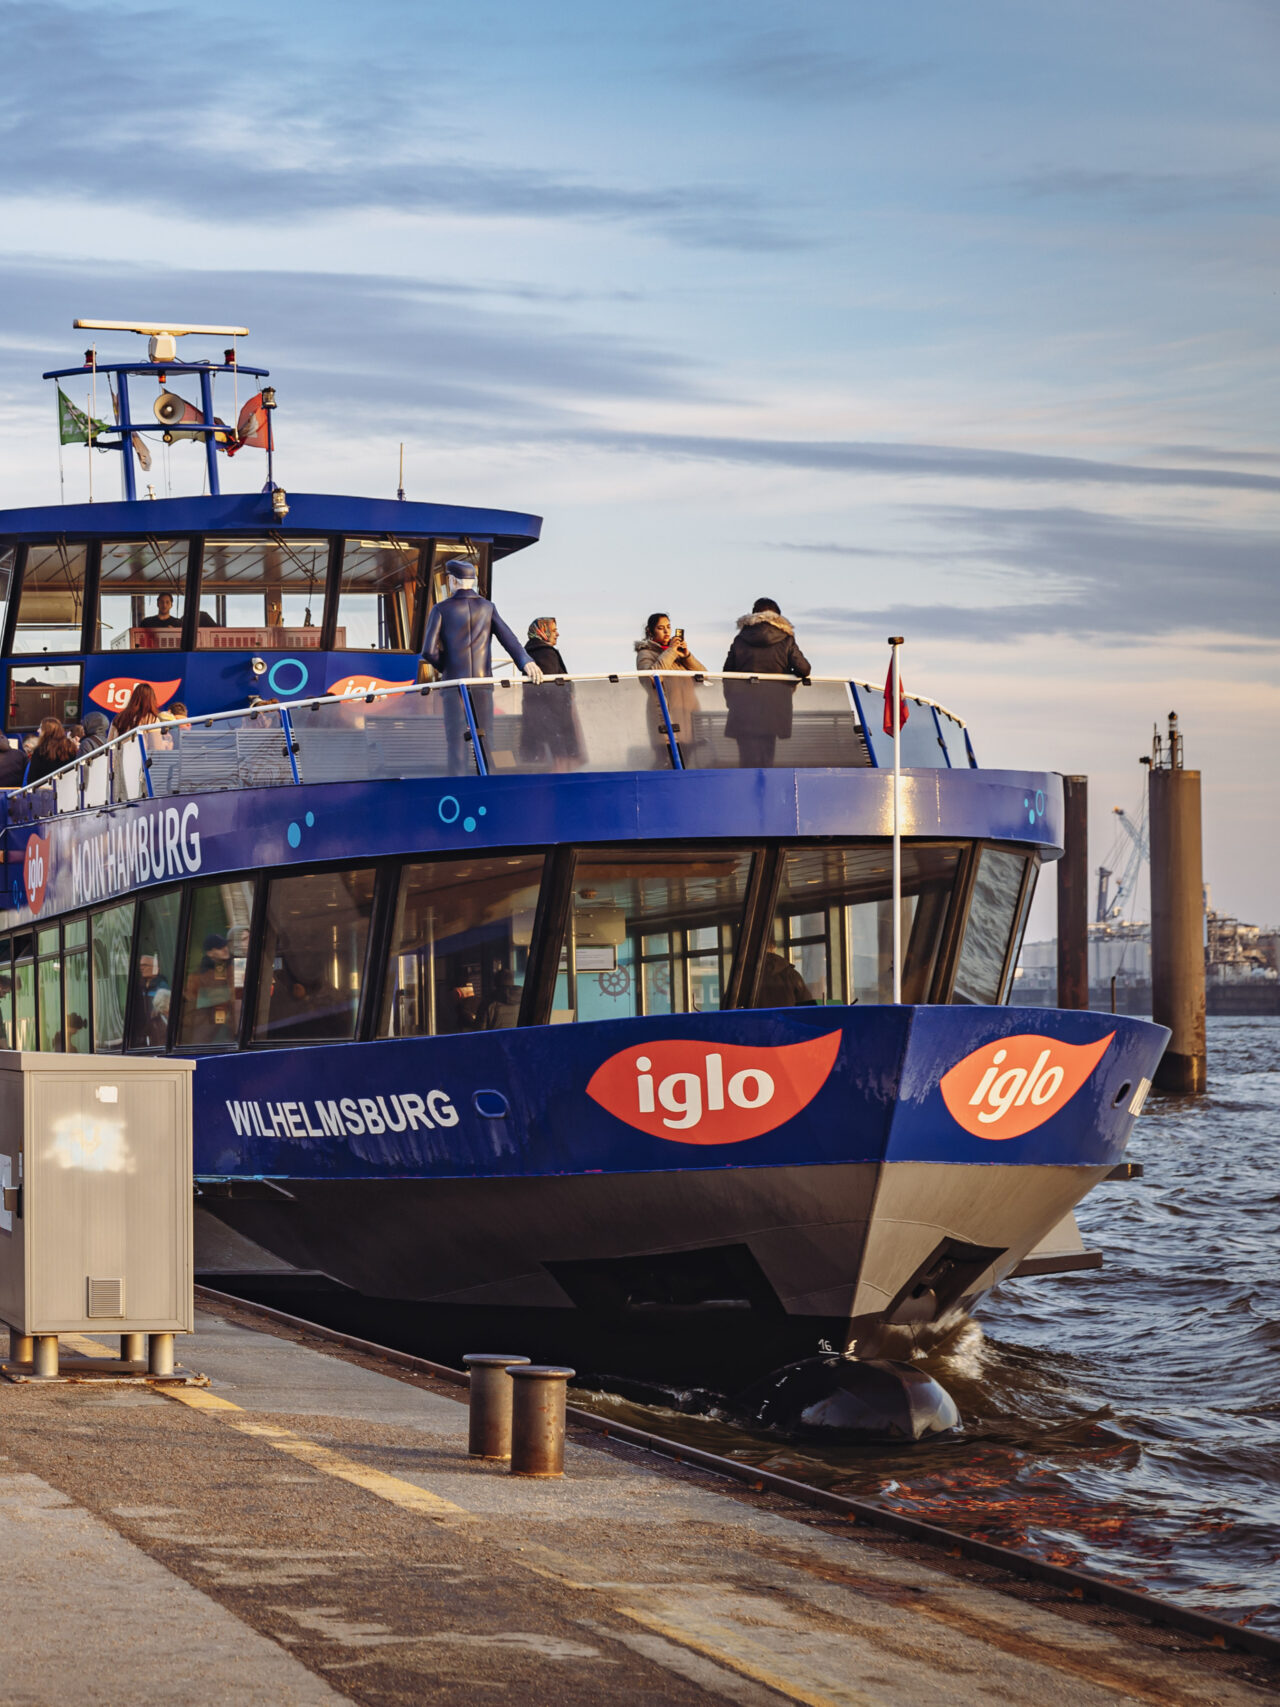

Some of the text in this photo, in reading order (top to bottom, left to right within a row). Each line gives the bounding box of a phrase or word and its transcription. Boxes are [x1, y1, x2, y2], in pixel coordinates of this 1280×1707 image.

[107, 683, 141, 709] ig
[28, 845, 44, 902] iglo
[72, 802, 202, 906] MOIN HAMBURG
[226, 1090, 460, 1138] WILHELMSBURG
[636, 1053, 775, 1130] iglo
[968, 1049, 1065, 1124] iglo
